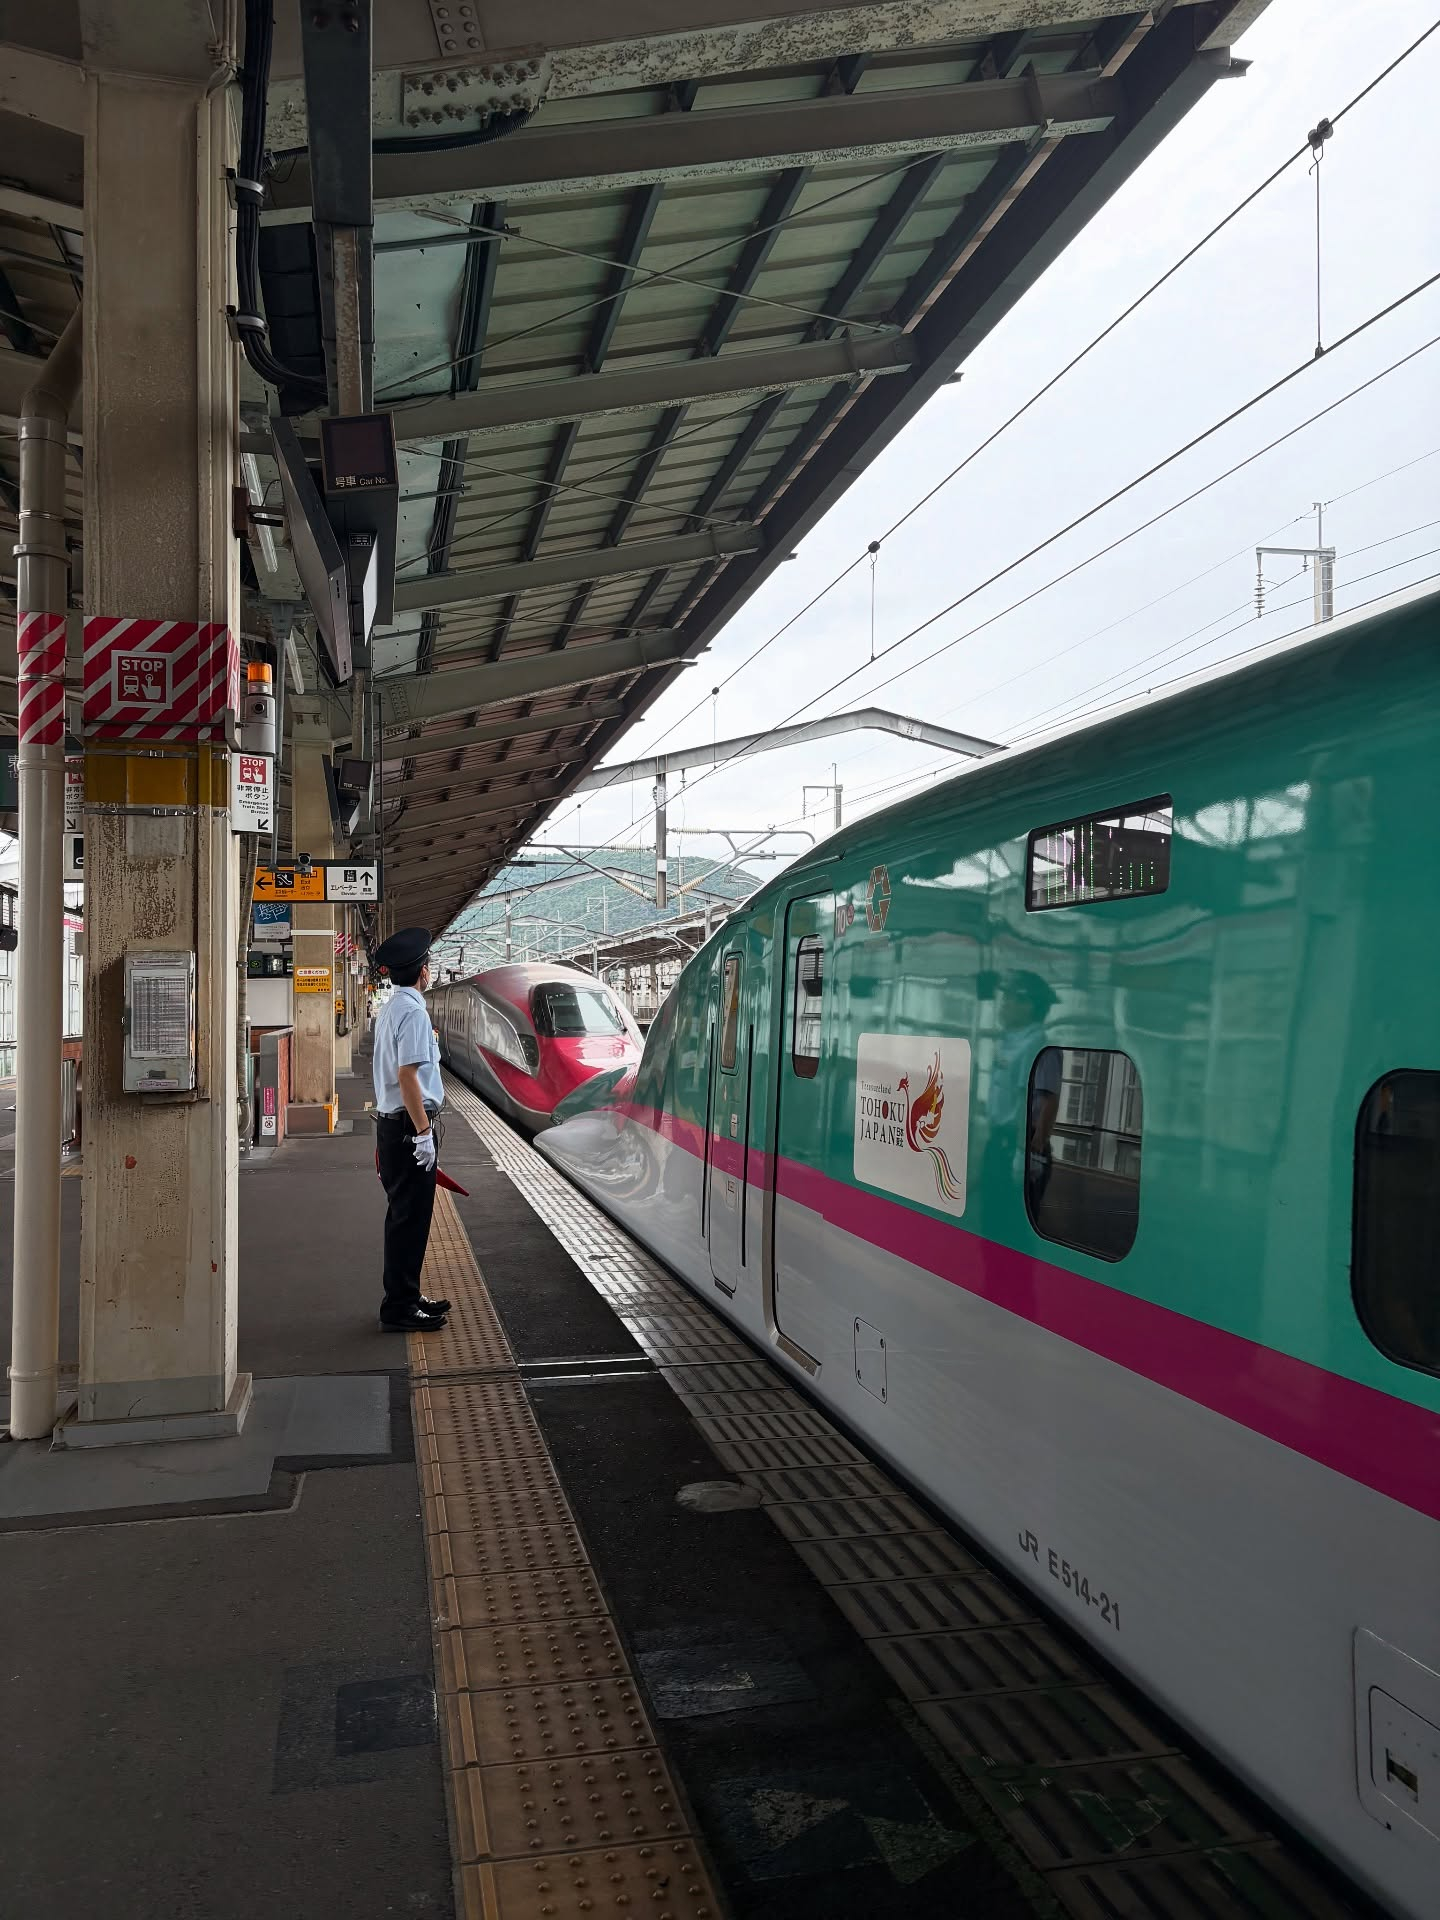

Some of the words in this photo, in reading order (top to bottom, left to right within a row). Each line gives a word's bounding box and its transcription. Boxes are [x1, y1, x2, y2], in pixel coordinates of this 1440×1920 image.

[121, 659, 164, 672] STOP
[242, 758, 264, 767] STOP
[245, 792, 269, 801] ボタン
[860, 1096, 905, 1123] TOHOKU
[860, 1119, 896, 1145] JAPAN
[1047, 1547, 1121, 1632] E514-21
